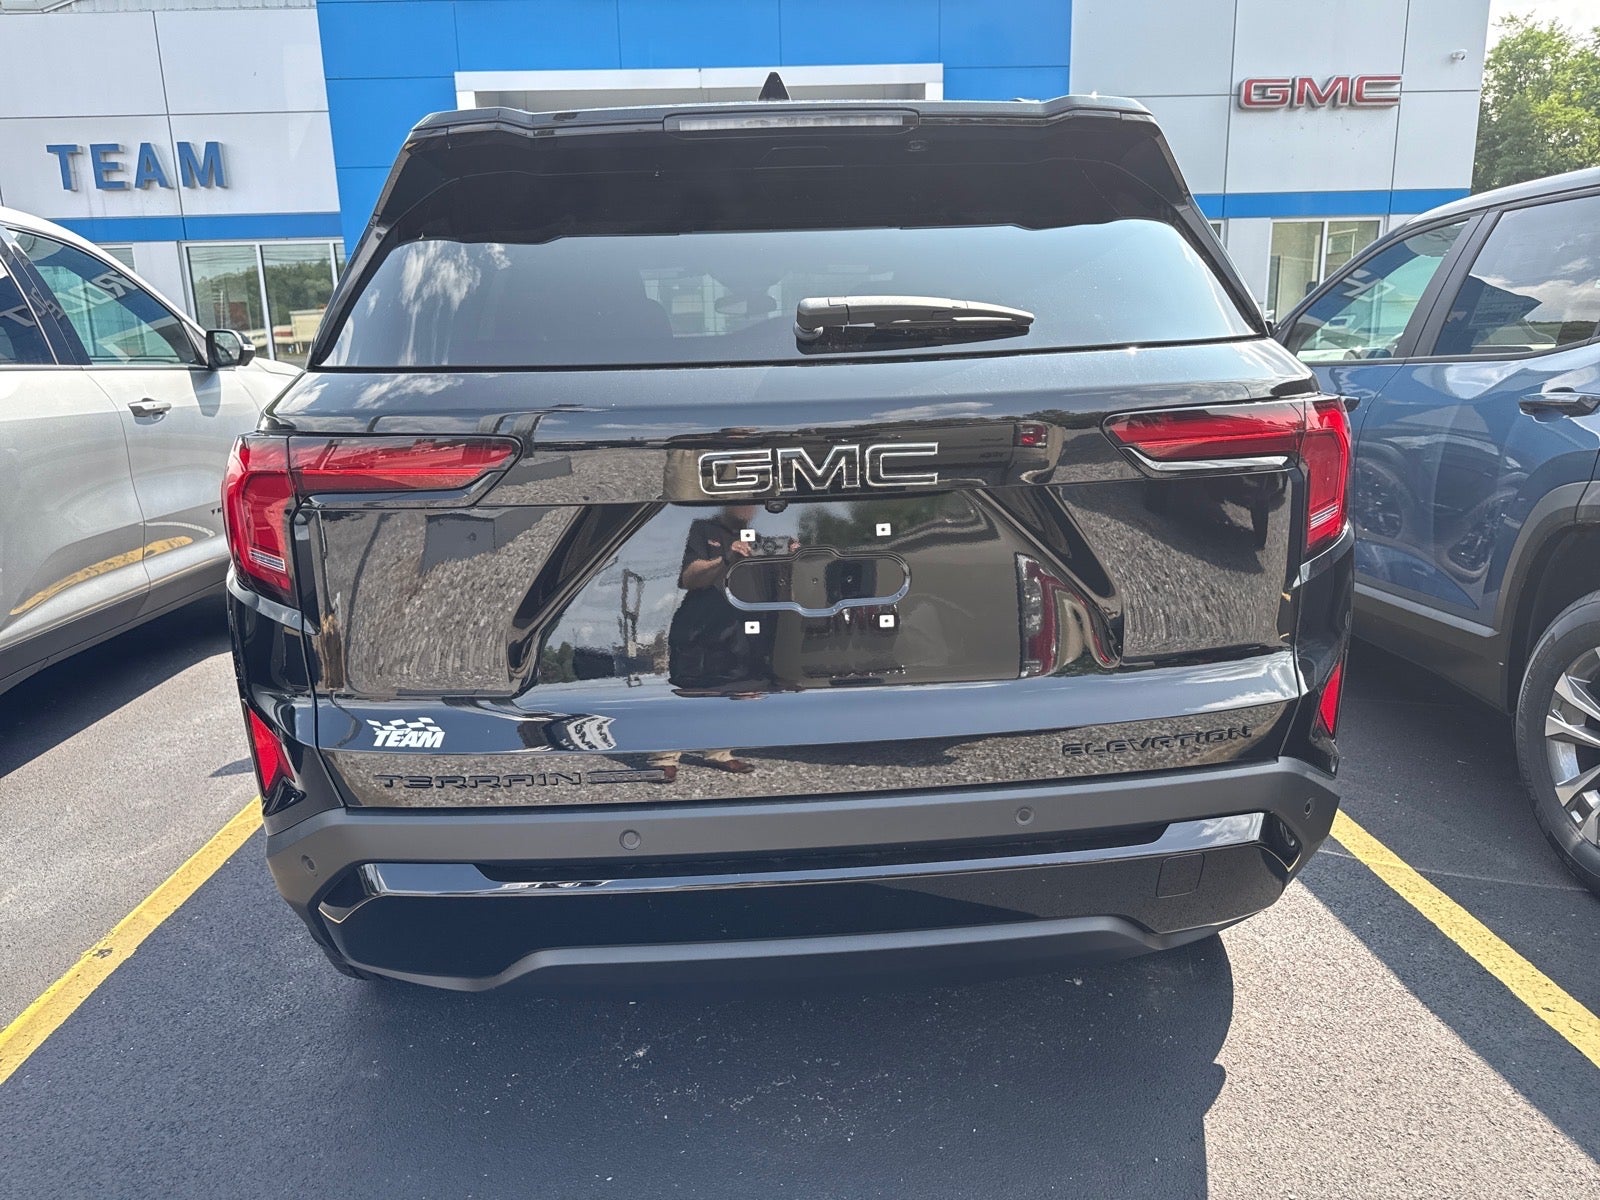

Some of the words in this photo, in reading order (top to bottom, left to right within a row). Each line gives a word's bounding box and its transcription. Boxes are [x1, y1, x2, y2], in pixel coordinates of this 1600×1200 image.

[1240, 74, 1402, 109] GMC
[46, 141, 228, 191] TEAM
[698, 442, 938, 495] GMC
[373, 729, 446, 748] TEAM
[1061, 725, 1252, 757] ELEVATION
[374, 772, 582, 788] TERRAIN
